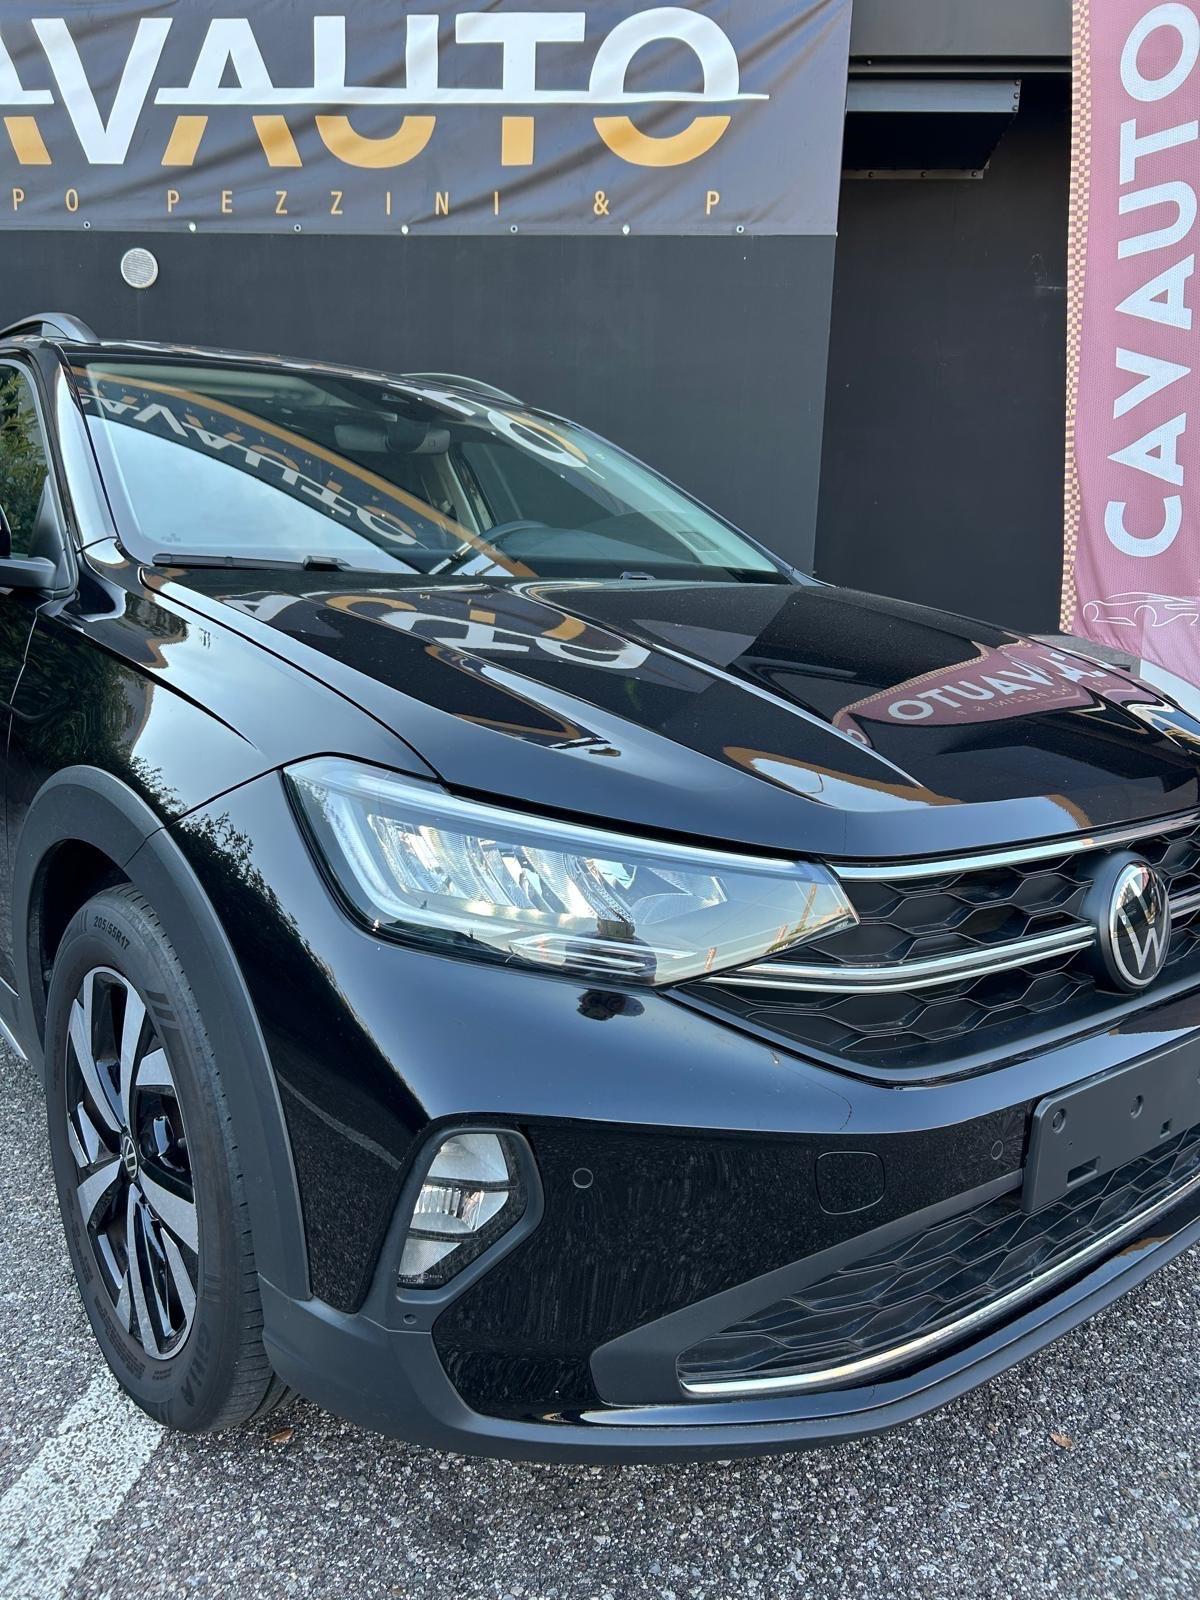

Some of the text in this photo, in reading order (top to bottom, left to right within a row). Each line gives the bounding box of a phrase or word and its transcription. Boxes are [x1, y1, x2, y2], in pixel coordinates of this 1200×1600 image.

[167, 190, 500, 215] PEZZINI
[593, 190, 610, 215] &
[706, 190, 720, 215] P
[1104, 2, 1200, 558] CAVAUTO
[94, 915, 130, 950] 205/55R17
